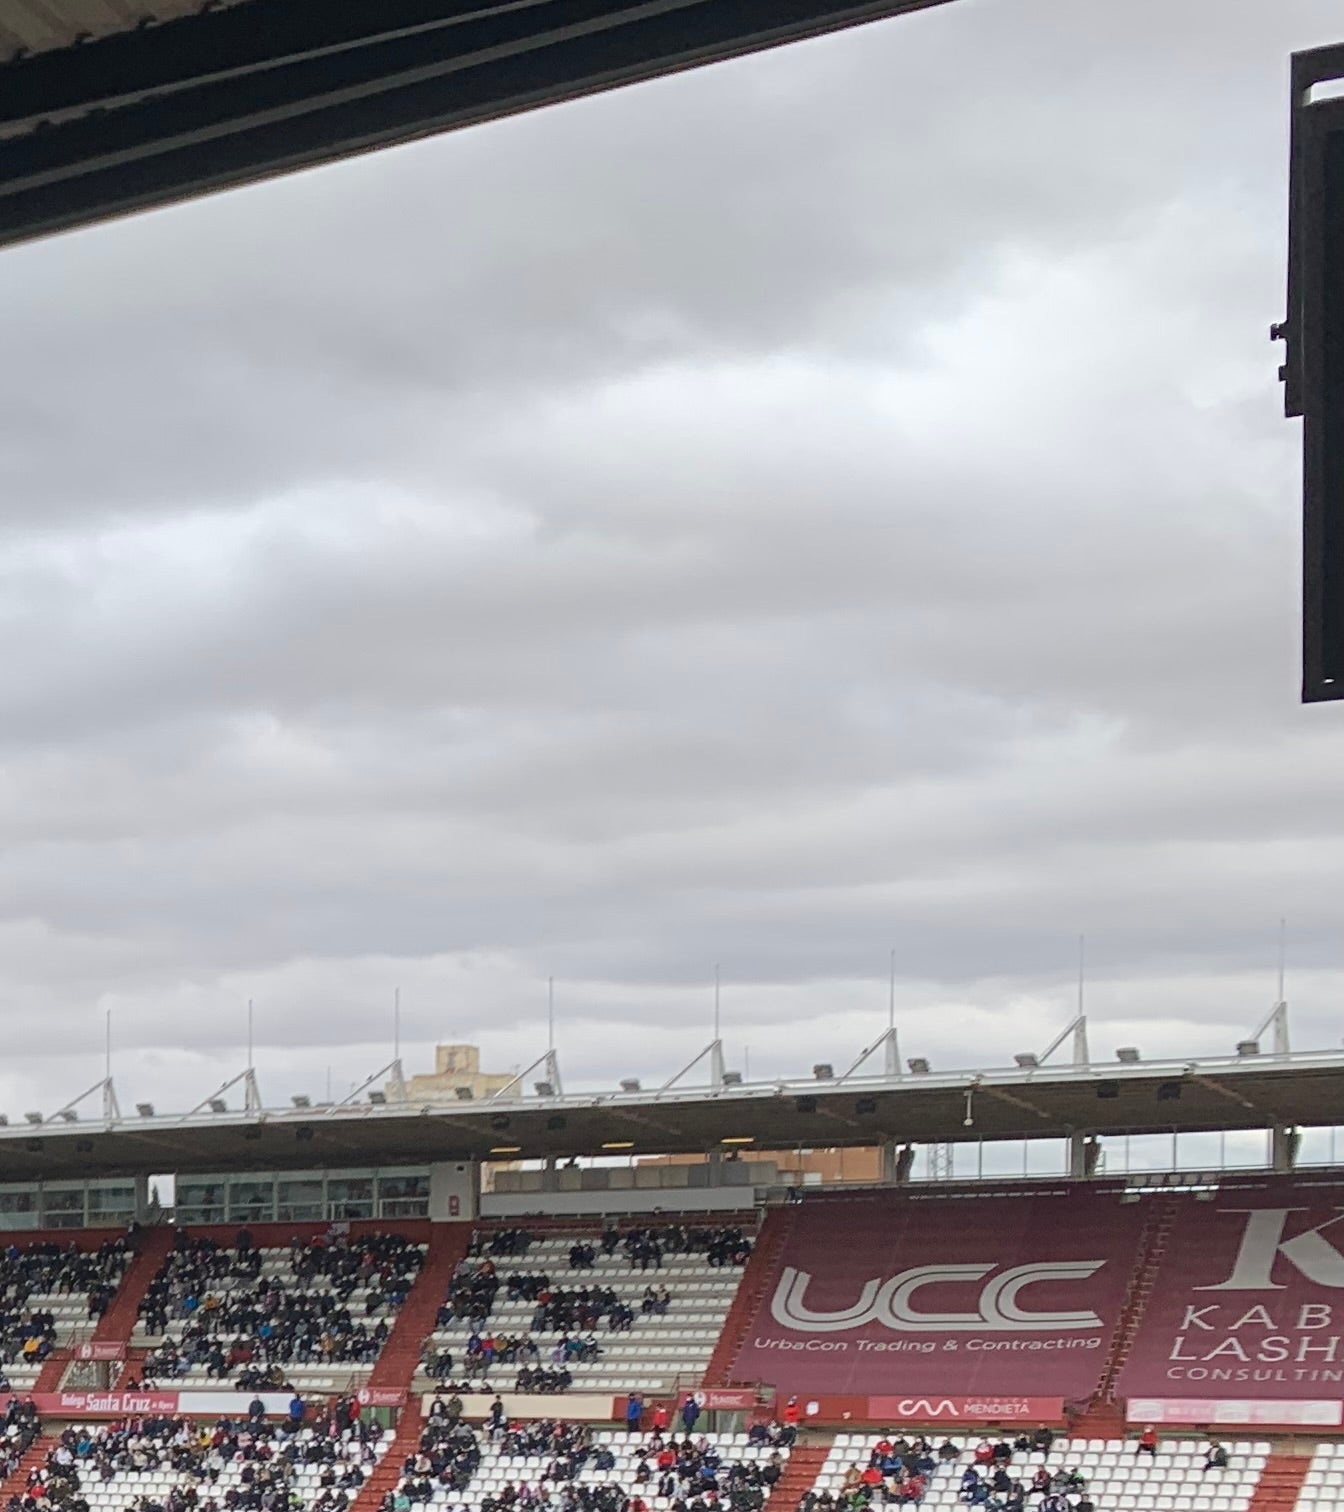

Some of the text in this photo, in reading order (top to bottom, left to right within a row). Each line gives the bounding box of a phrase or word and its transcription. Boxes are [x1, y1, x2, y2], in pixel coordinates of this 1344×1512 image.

[770, 1259, 1109, 1333] UCC
[1179, 1303, 1333, 1331] KAB
[754, 1332, 1102, 1356] UrbaCon Trading & Contracting
[1168, 1336, 1344, 1362] LASH
